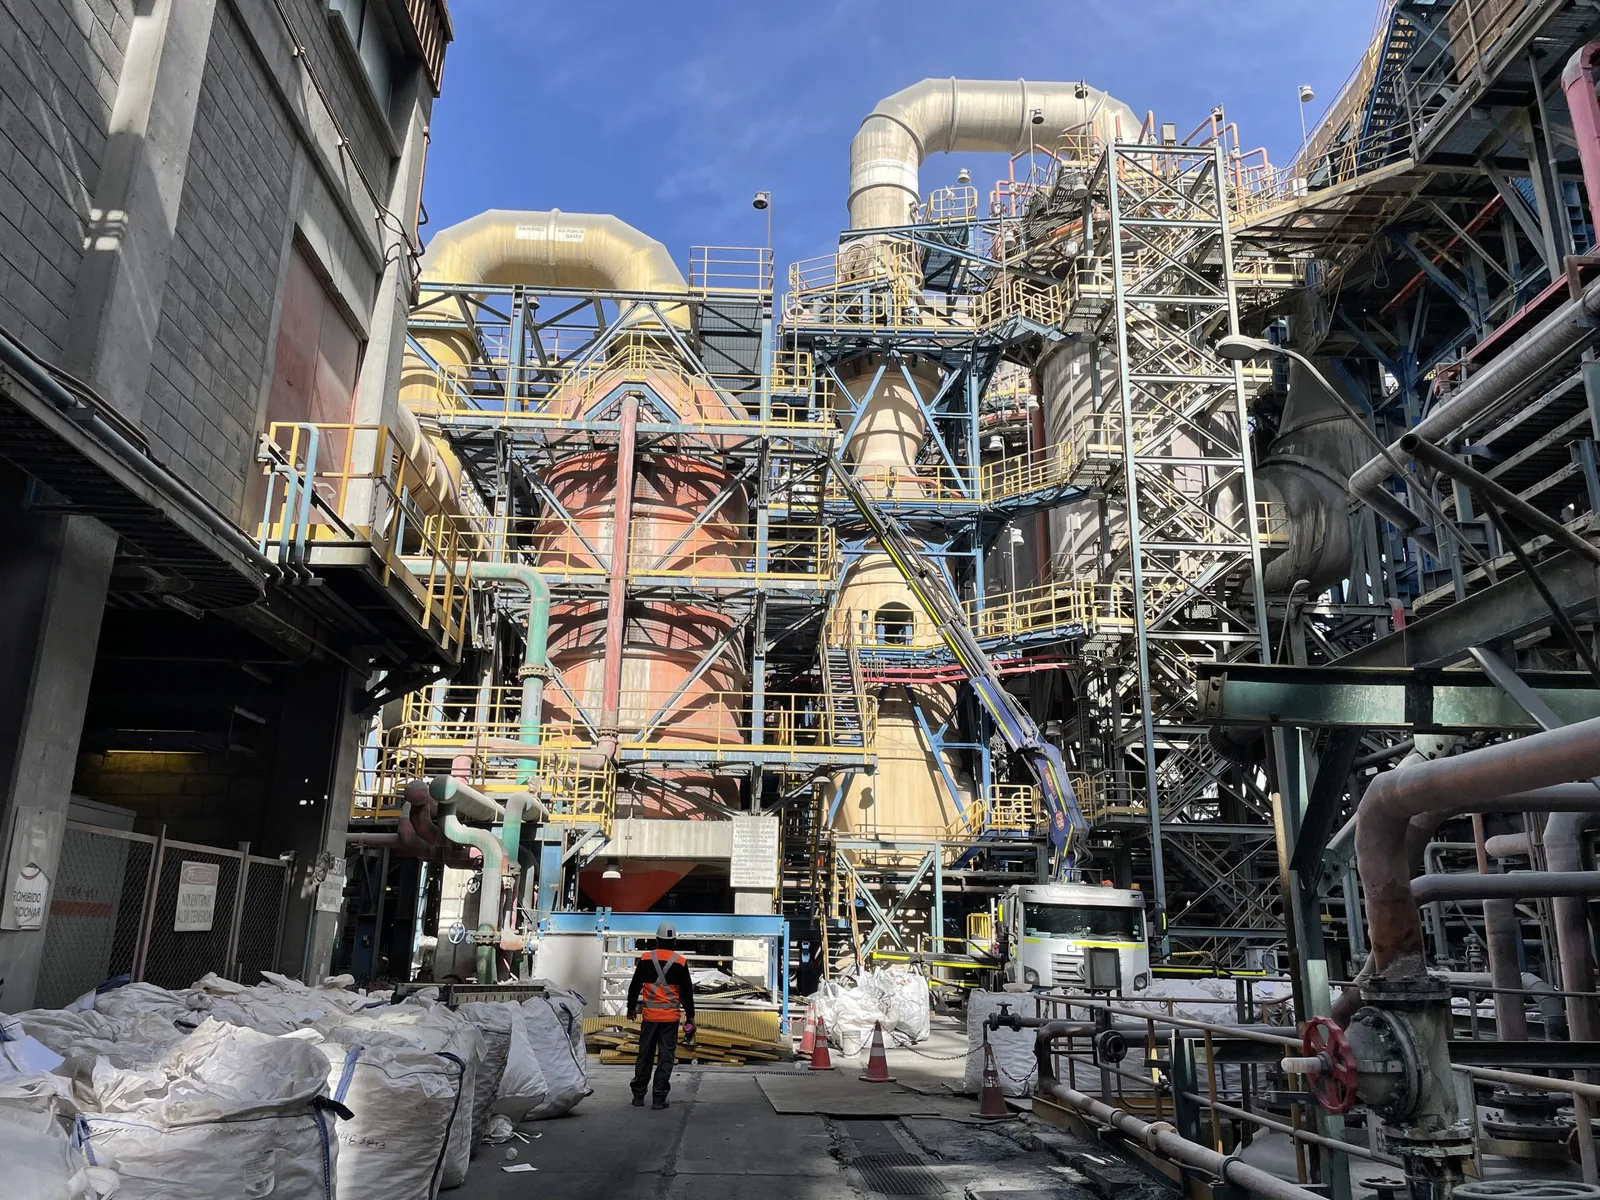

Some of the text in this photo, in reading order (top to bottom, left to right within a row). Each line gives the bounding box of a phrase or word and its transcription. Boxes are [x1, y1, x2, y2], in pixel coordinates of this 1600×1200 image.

[182, 893, 212, 908] NO ENTRAR
[176, 909, 212, 924] ALTA TENSION
